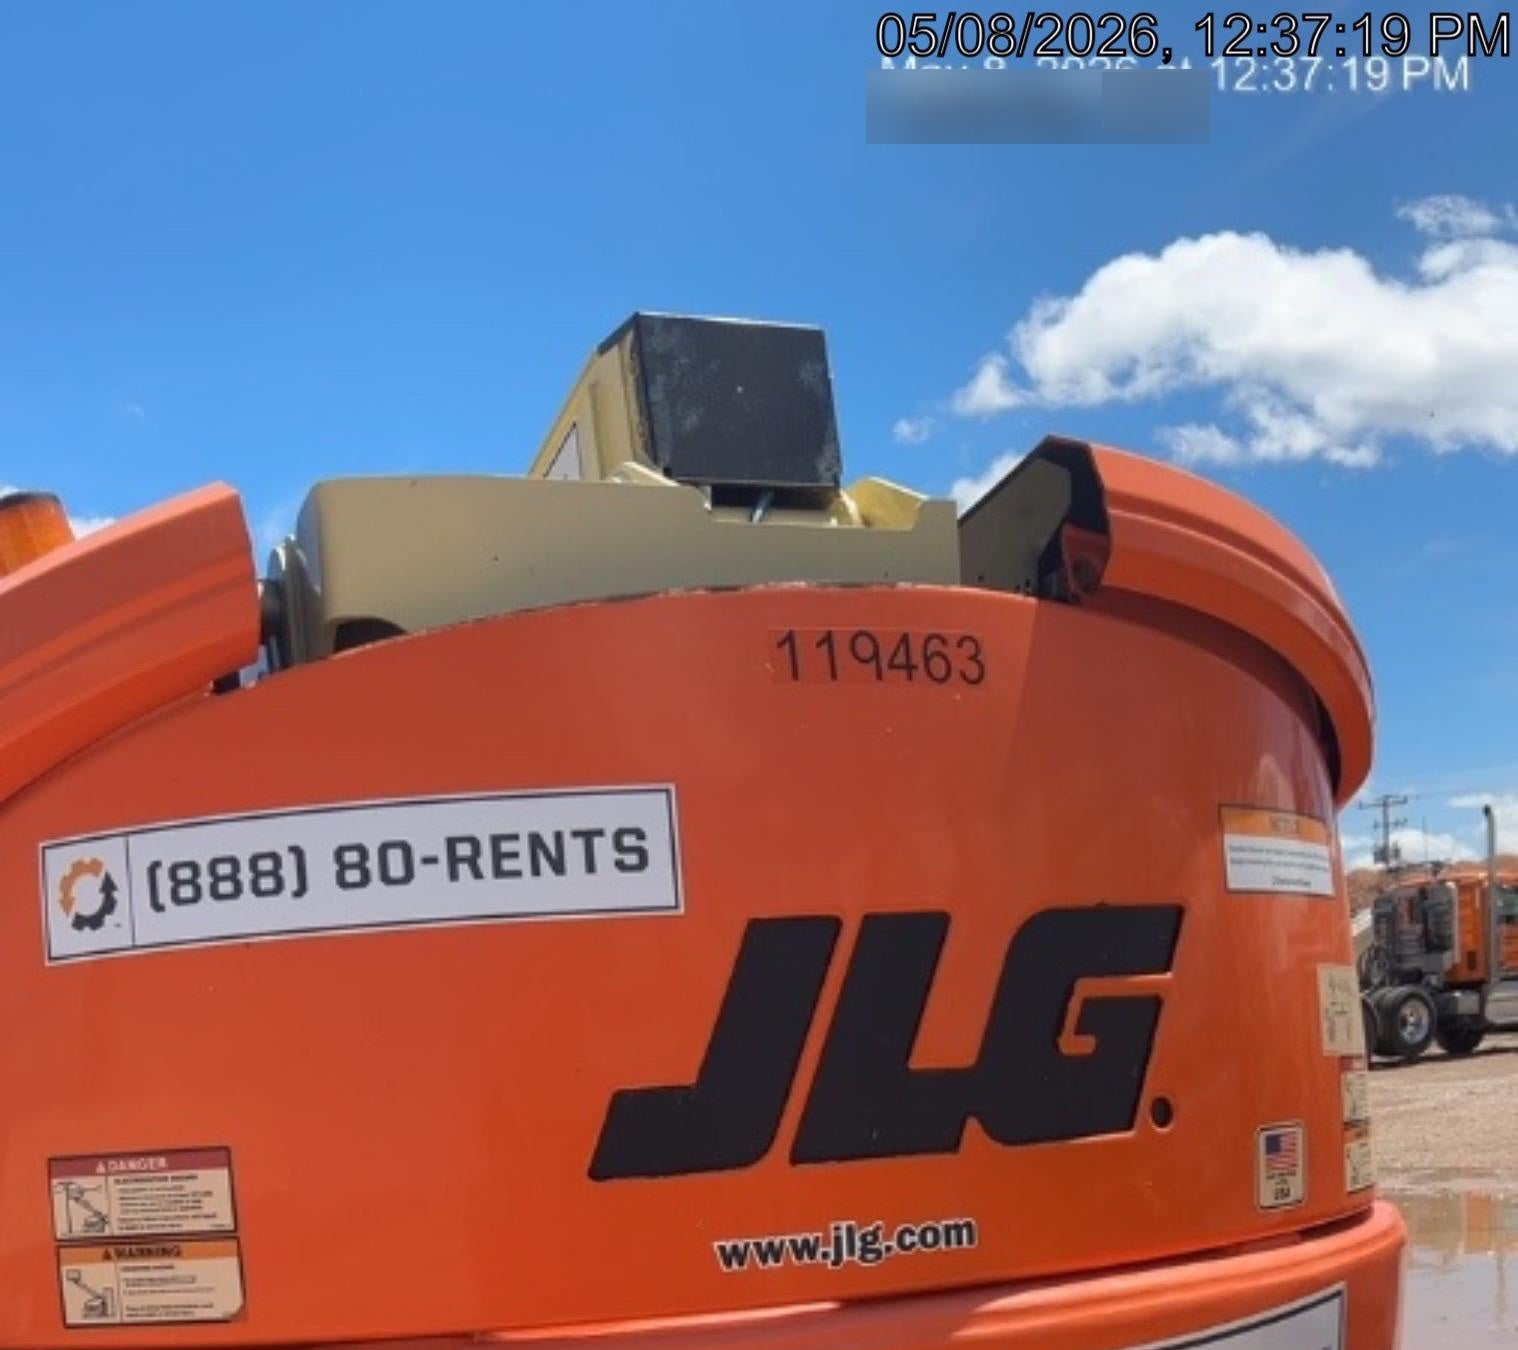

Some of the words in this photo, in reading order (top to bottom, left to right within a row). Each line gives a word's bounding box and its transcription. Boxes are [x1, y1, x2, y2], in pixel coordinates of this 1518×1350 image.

[776, 629, 986, 686] 119463
[146, 845, 308, 913] (888)
[333, 826, 649, 891] 80-RENTS
[107, 1156, 168, 1173] DANGER
[113, 1245, 182, 1260] WARNING
[714, 1218, 976, 1271] www.jlg.com
